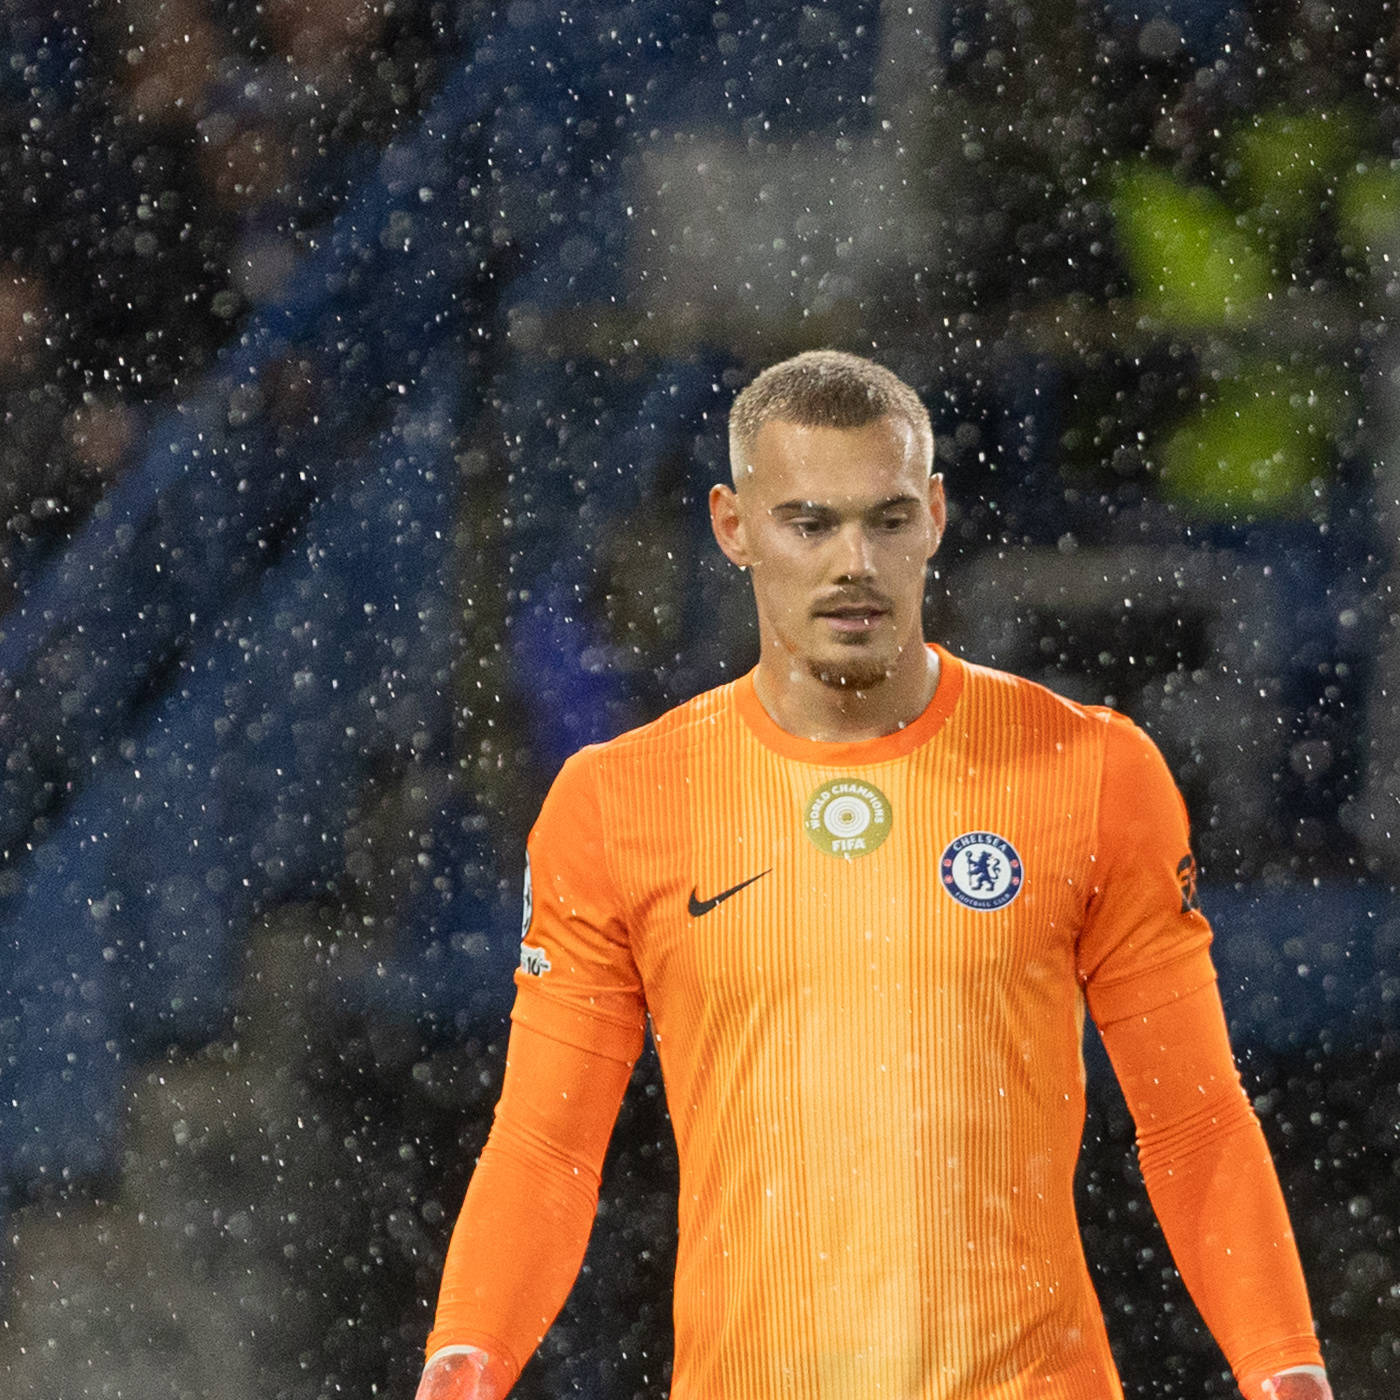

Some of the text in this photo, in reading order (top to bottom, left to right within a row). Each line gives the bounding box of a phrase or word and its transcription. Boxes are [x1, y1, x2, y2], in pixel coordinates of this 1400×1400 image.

[810, 784, 884, 830] WORLD CHAMPIONS
[831, 838, 866, 852] FIFA
[952, 834, 1007, 852] CHELSEA
